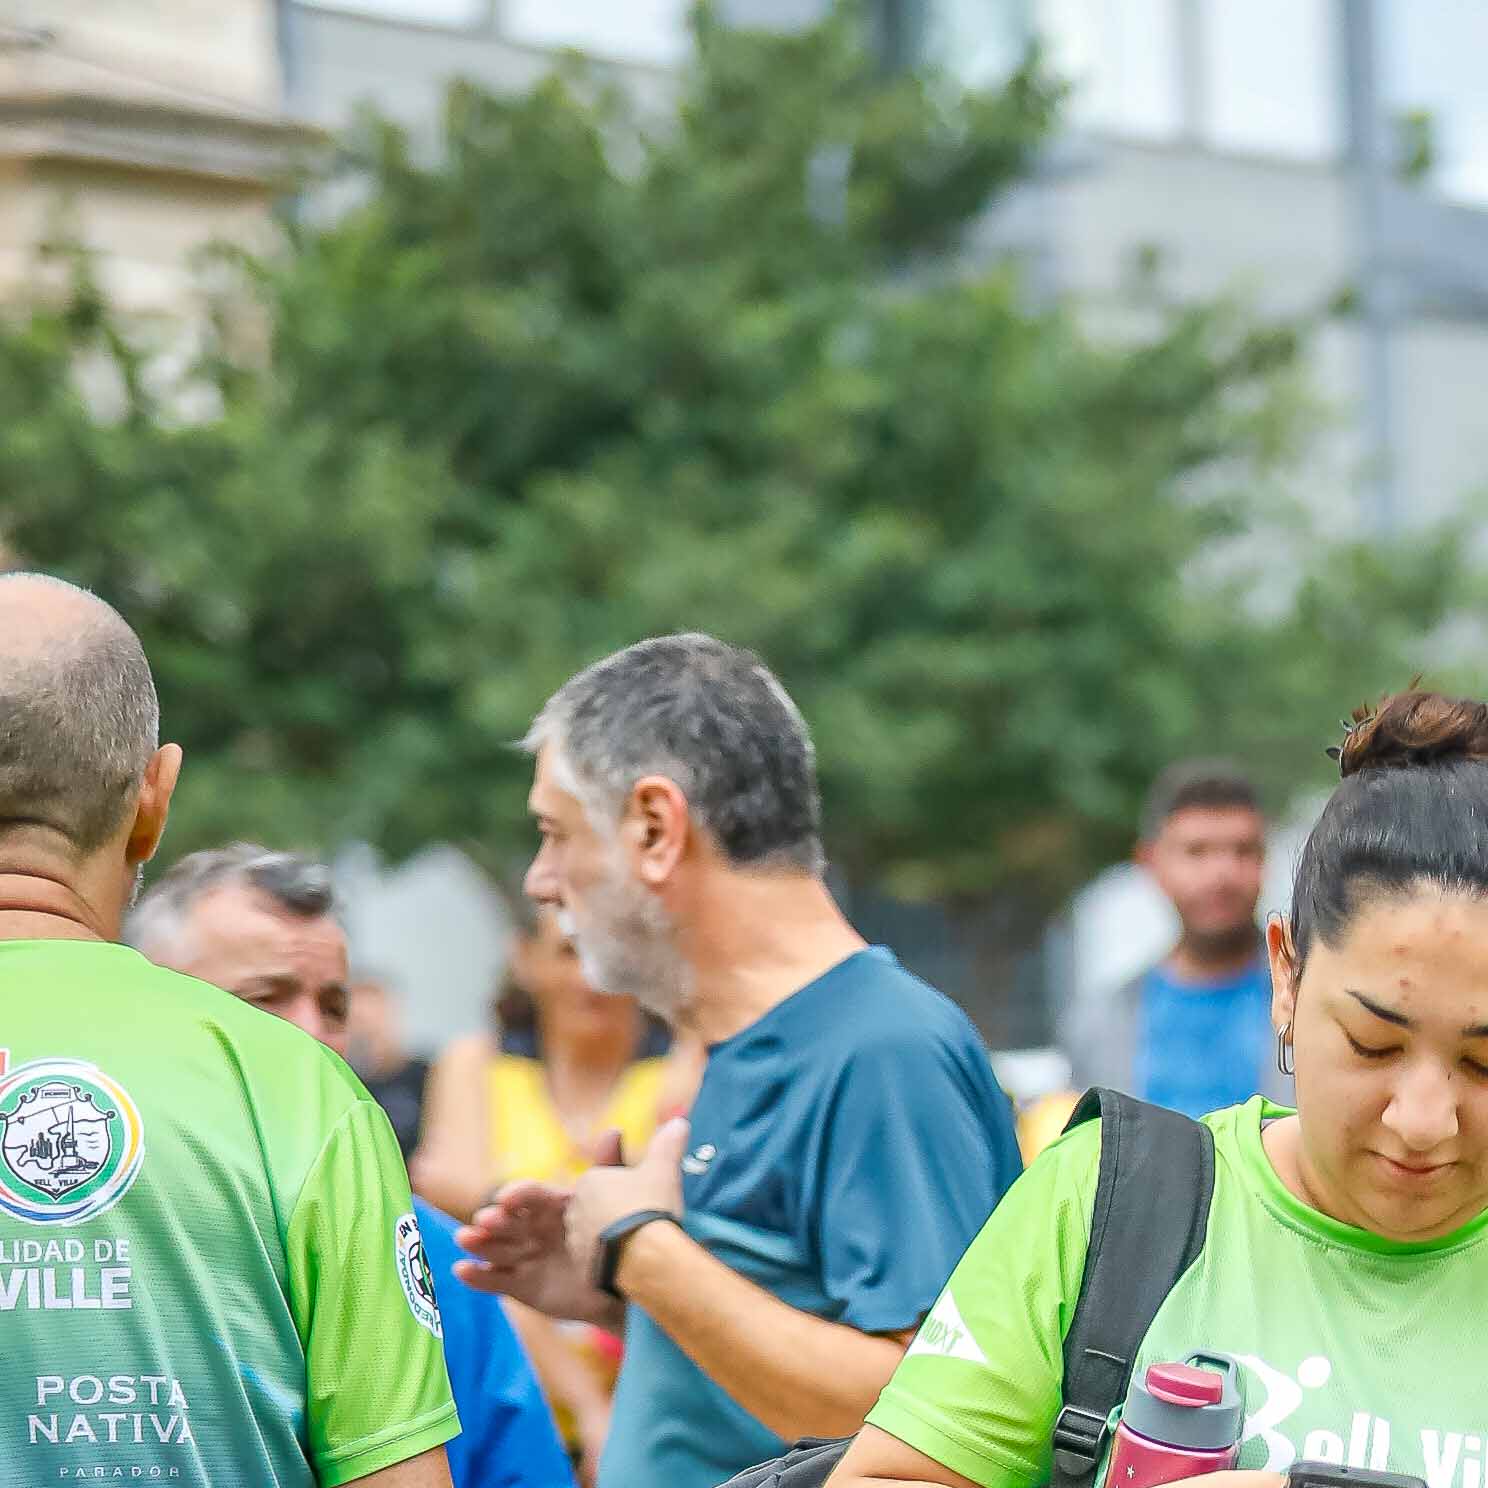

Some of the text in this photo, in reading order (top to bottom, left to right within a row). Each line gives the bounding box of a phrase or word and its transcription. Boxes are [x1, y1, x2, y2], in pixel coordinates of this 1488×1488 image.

[94, 1239, 130, 1263] DE
[36, 1375, 189, 1409] POSTA
[27, 1413, 195, 1444] NATIVA
